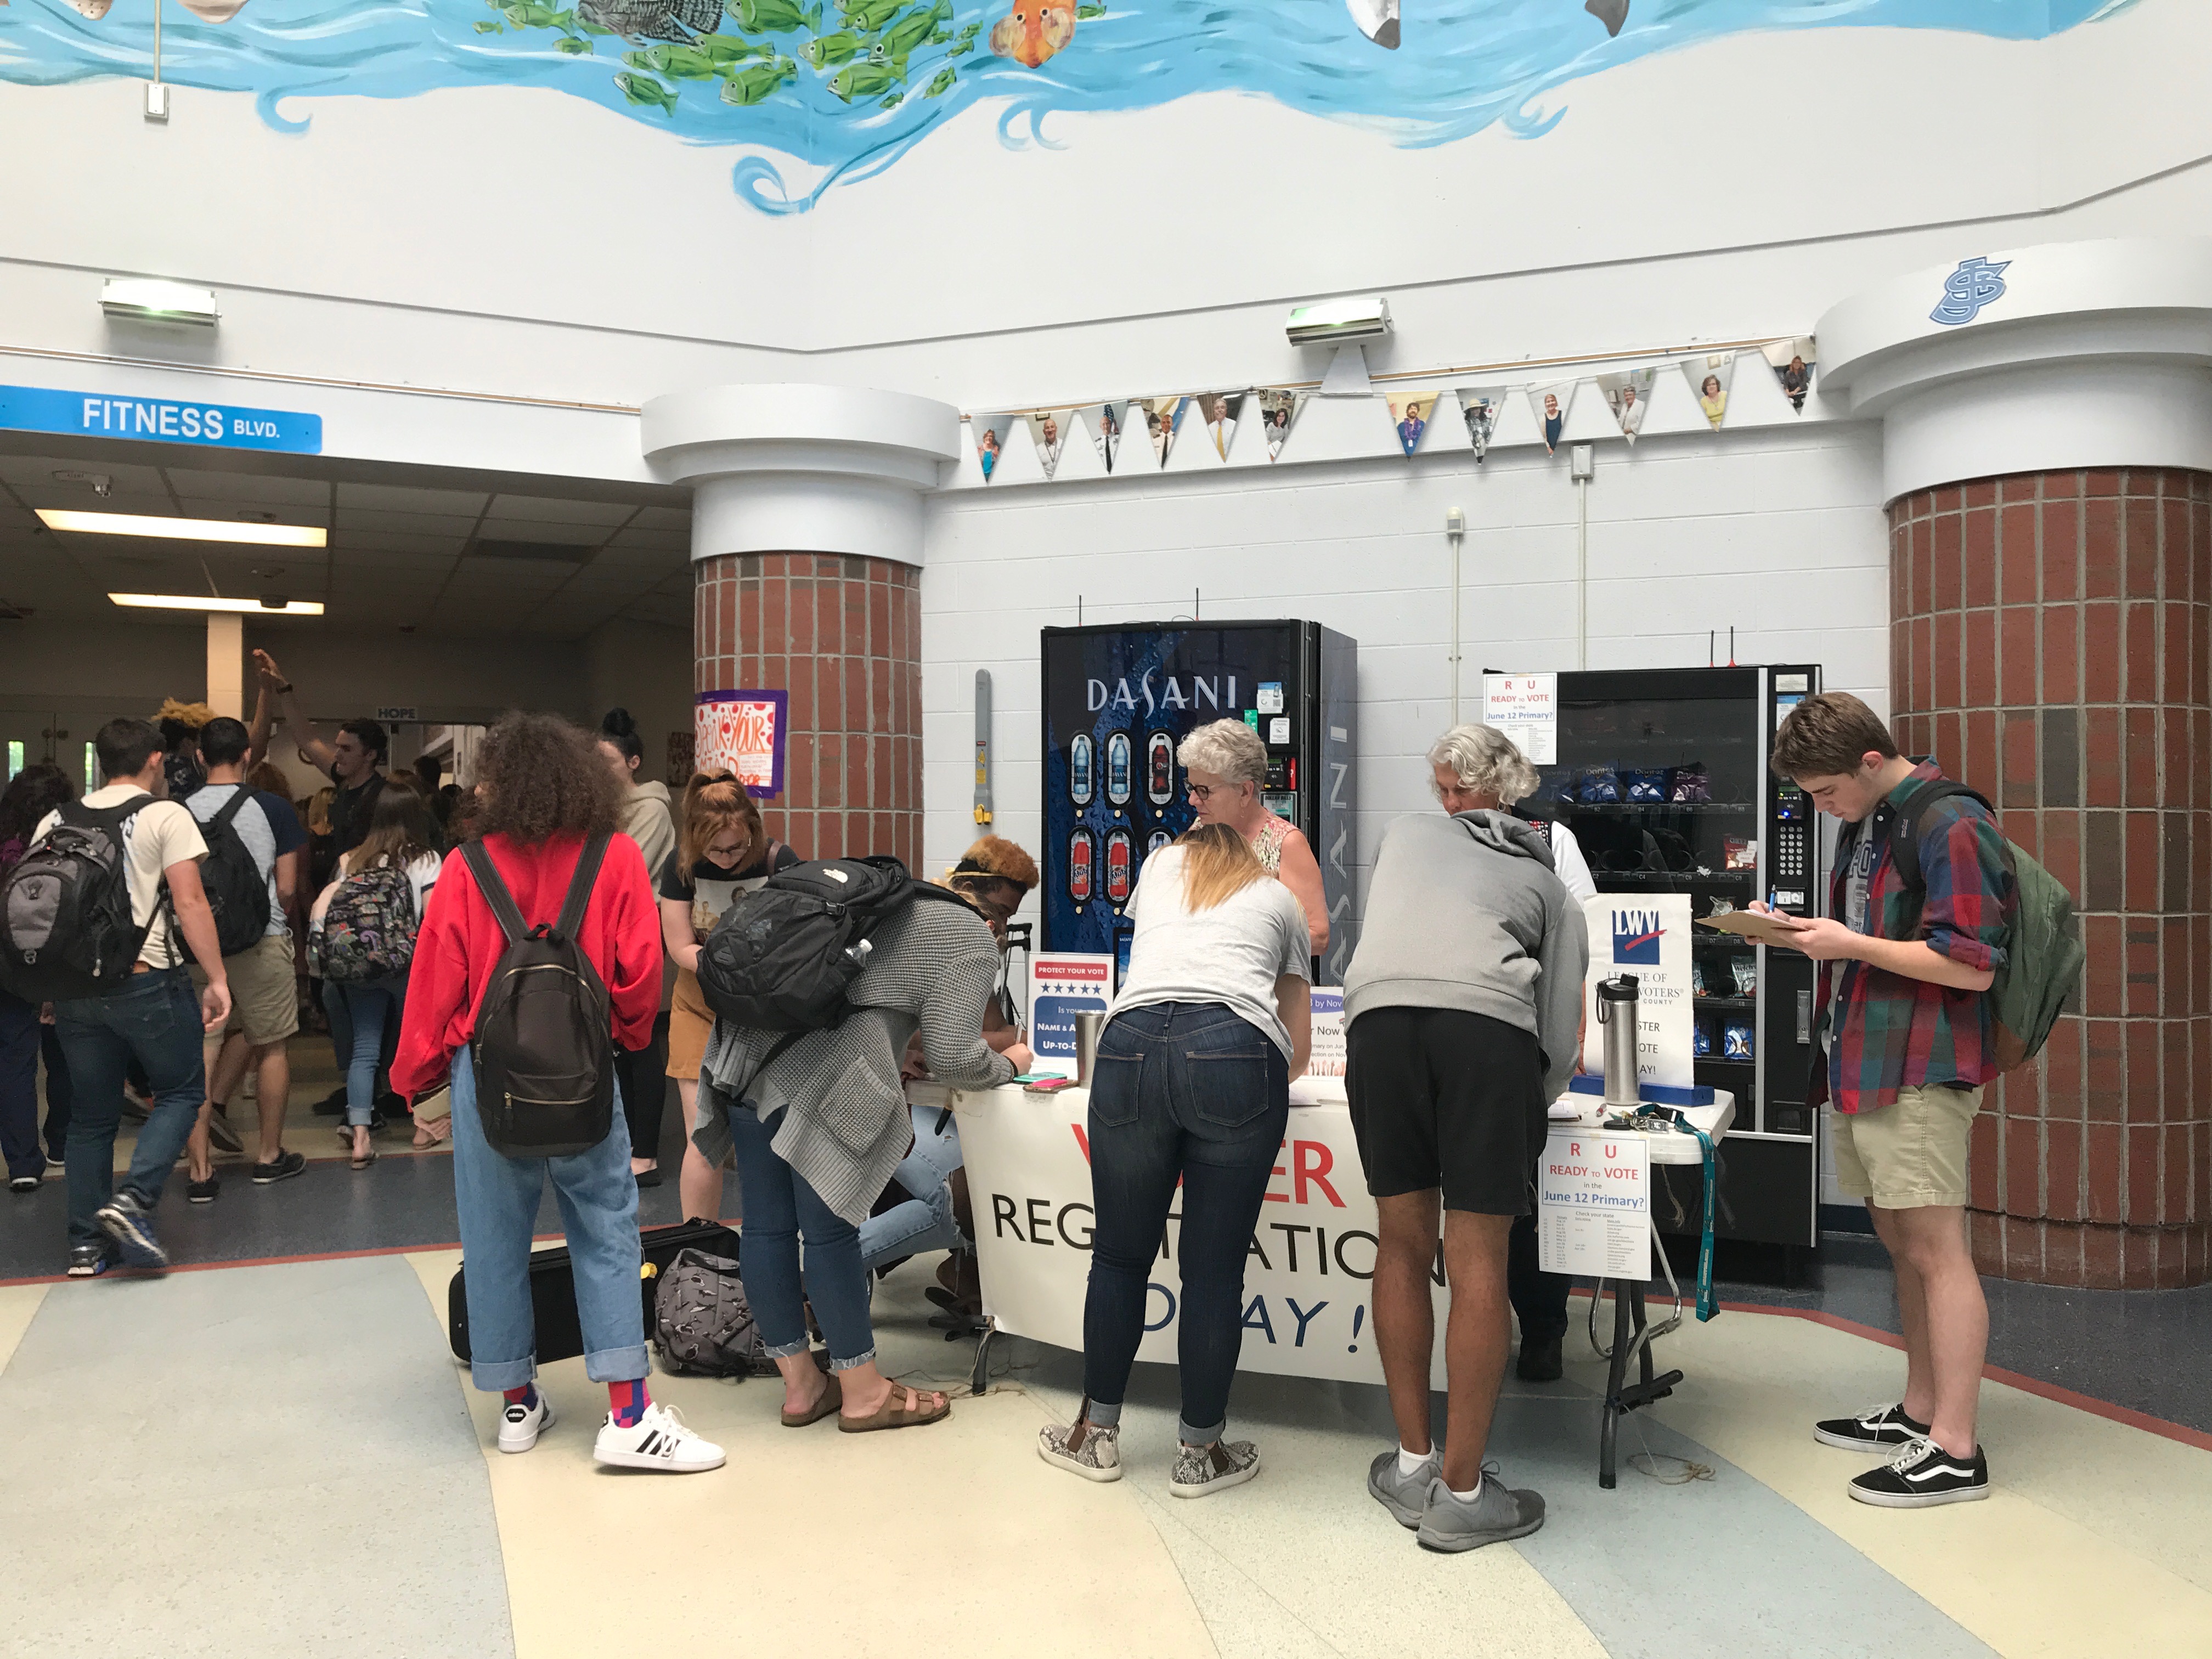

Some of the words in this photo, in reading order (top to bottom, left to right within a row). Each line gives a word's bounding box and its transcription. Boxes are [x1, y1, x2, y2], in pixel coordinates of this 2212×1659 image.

[83, 398, 224, 439] FITNESS
[233, 419, 280, 438] BLVD.
[1505, 680, 1512, 690] R
[1527, 680, 1536, 690] U
[1087, 665, 1236, 719] DASANI
[1526, 694, 1549, 702] VOTE
[377, 708, 416, 719] HOPE
[1519, 712, 1553, 720] Primary?
[727, 704, 765, 753] YOUR
[1585, 766, 1615, 775] Doritos
[1328, 725, 1351, 985] ASANI
[1615, 910, 1659, 936] LWV
[1652, 973, 1667, 983] OF
[1315, 1000, 1325, 1009] by
[1317, 1026, 1340, 1036] Now
[1639, 1043, 1658, 1054] OTE
[1570, 1142, 1581, 1156] R
[1605, 1144, 1617, 1159] U
[1550, 1165, 1588, 1177] READY
[1604, 1167, 1639, 1180] VOTE
[1544, 1190, 1571, 1202] June
[1575, 1193, 1588, 1203] 12
[1592, 1193, 1644, 1209] Primary?
